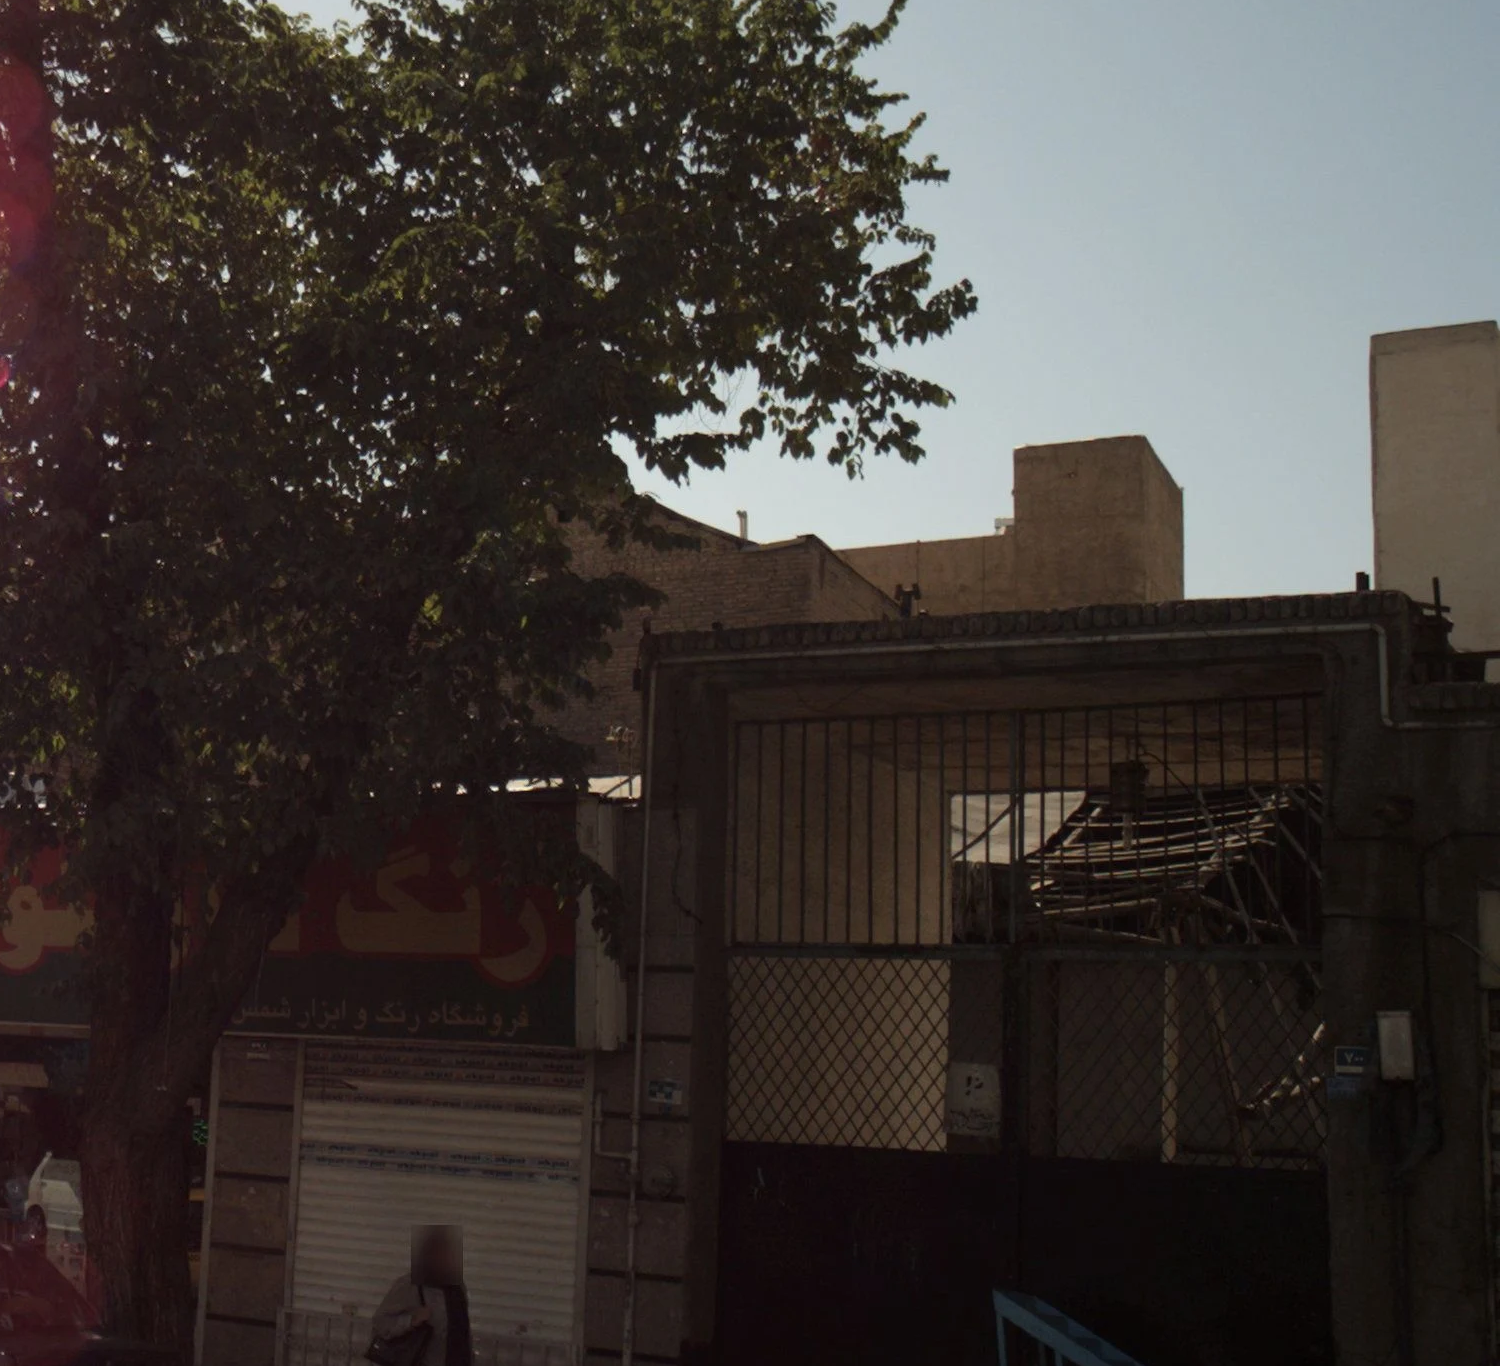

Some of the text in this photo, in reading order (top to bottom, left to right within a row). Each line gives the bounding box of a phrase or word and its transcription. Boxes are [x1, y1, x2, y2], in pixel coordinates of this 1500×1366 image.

[298, 997, 348, 1032] ابزار
[355, 1007, 367, 1030] و
[375, 999, 421, 1033] رنگ
[427, 1000, 531, 1038] فروشگاه
